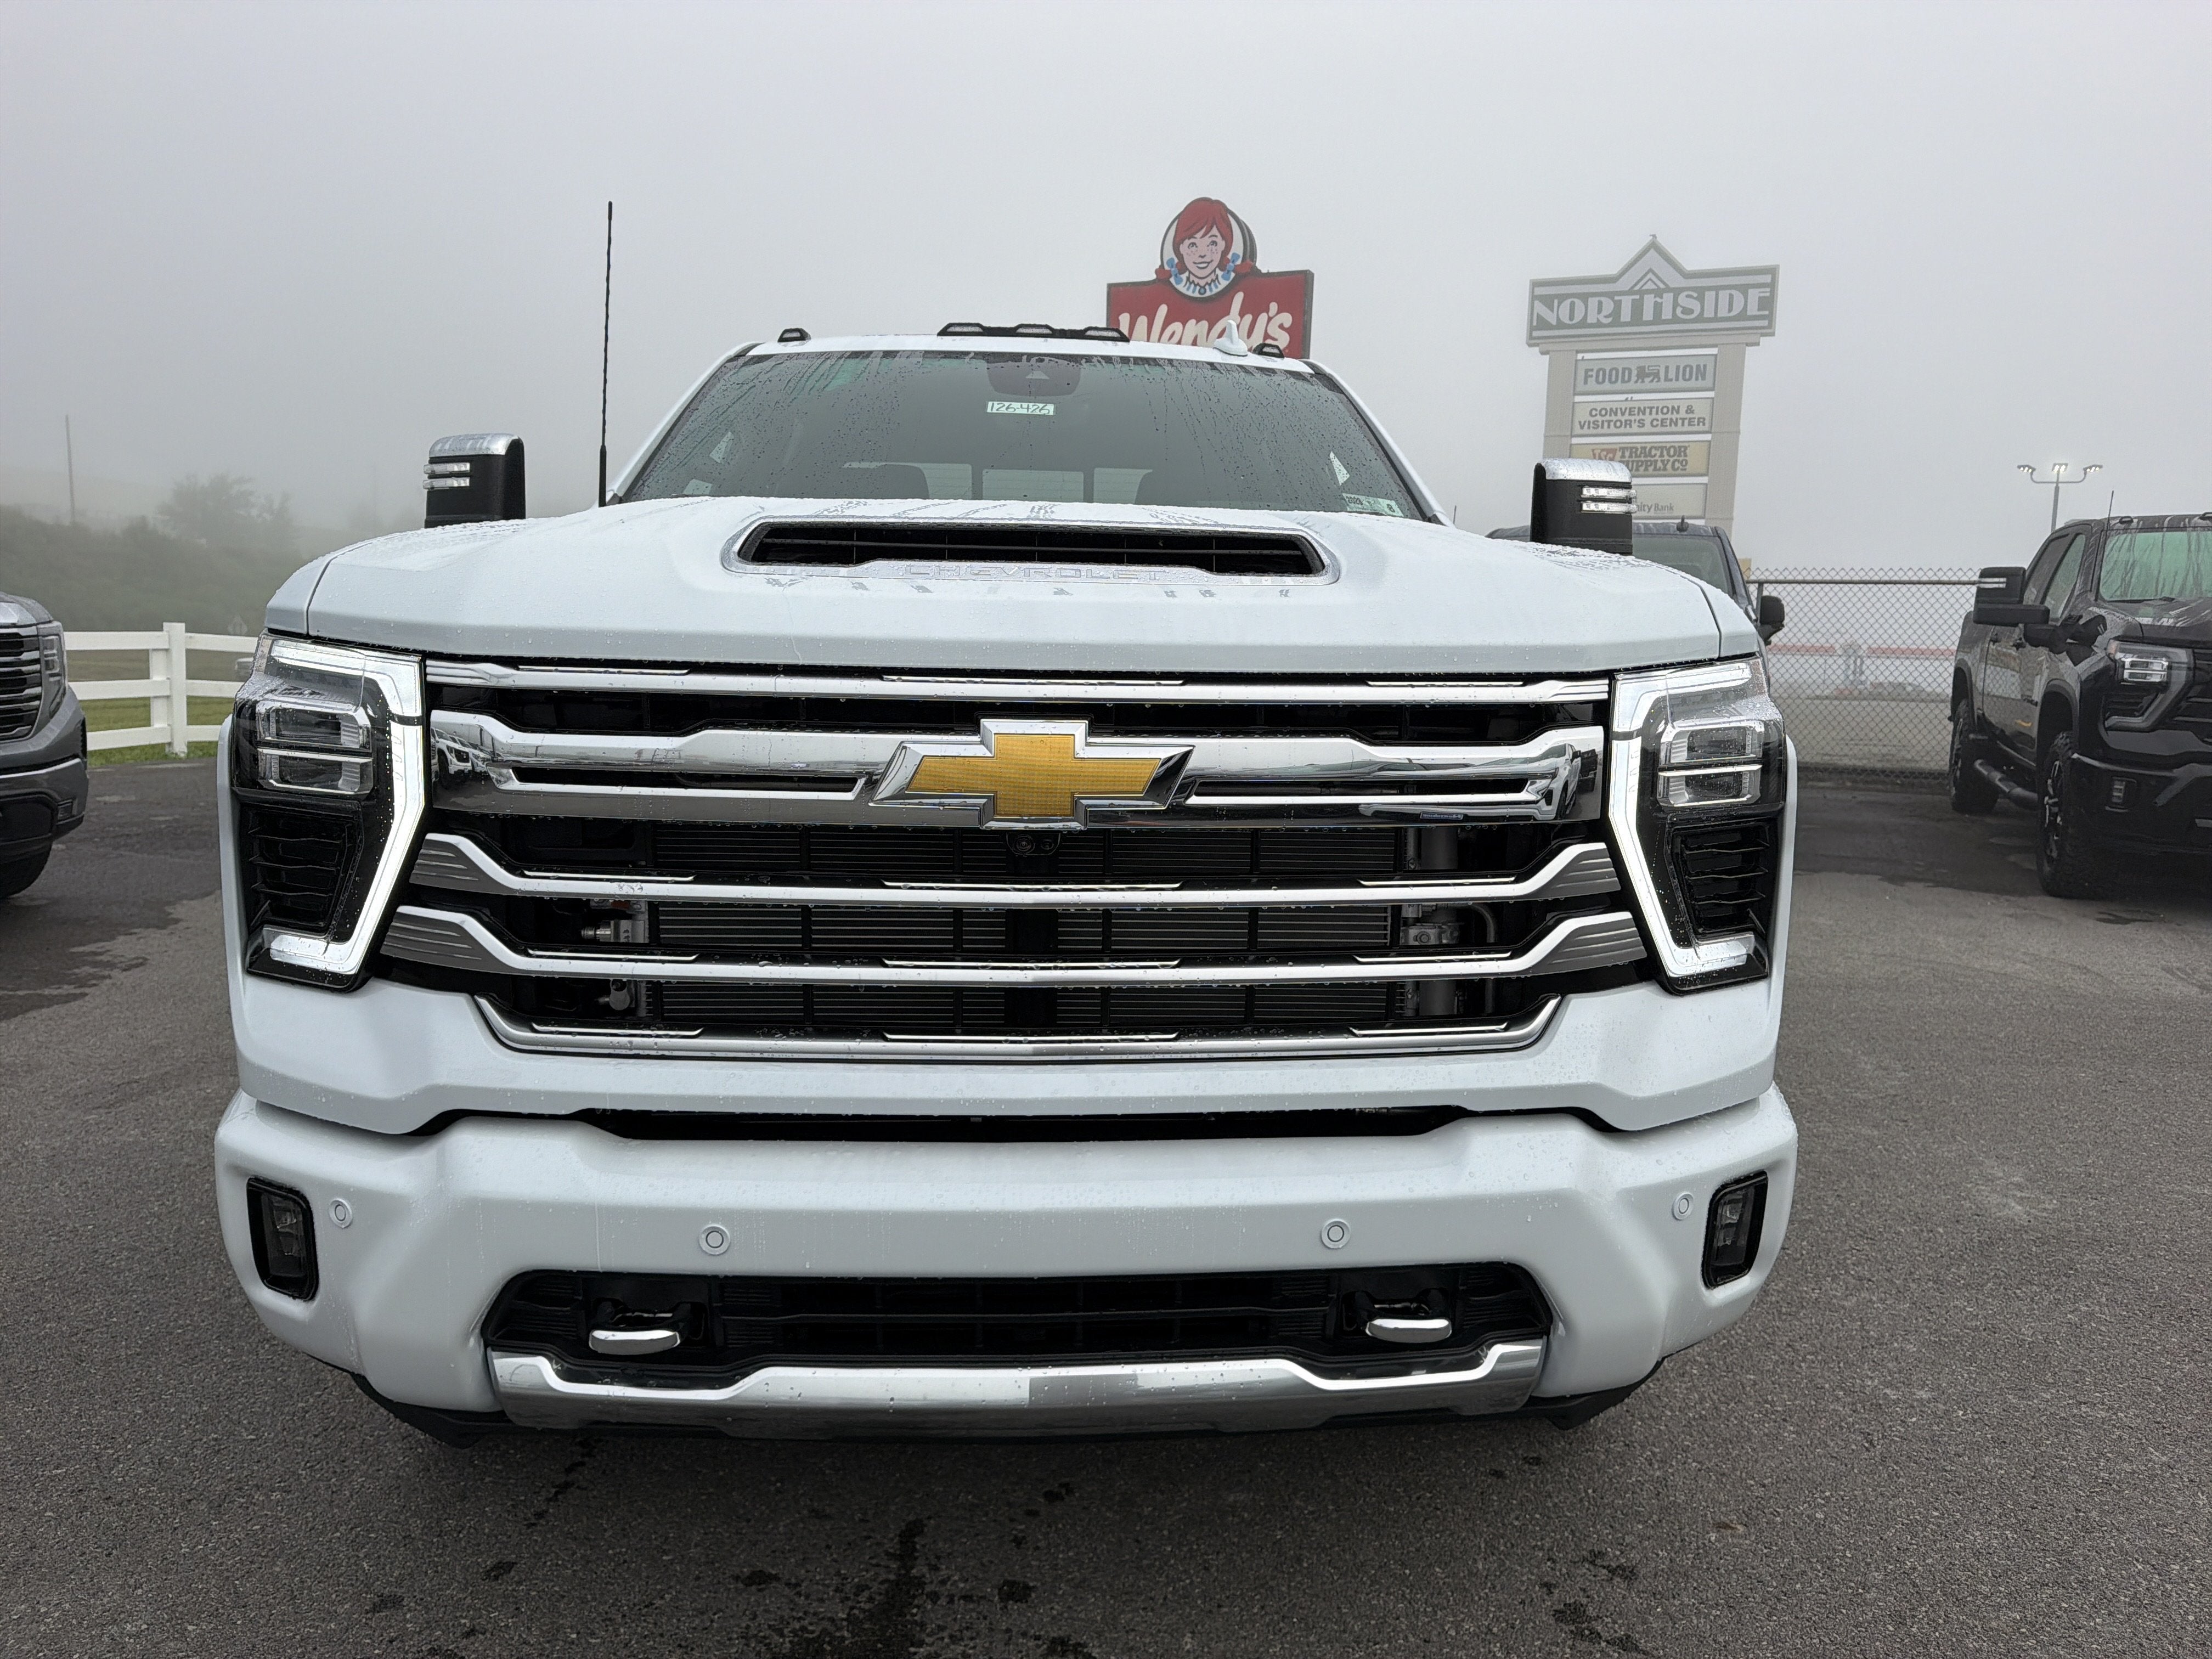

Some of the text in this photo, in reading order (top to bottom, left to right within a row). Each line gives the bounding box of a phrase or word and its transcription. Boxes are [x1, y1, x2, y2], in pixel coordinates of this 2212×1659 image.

[1533, 287, 1771, 326] NORTHSIDE
[1118, 291, 1293, 353] Wendy's
[1583, 364, 1708, 385] FOOD LION
[990, 402, 1051, 415] 126-426
[1588, 404, 1695, 418] CONVENTION &
[1578, 417, 1706, 430] VISITOR'S CENTER
[1618, 445, 1689, 459] TRACTOR
[1619, 459, 1670, 472] UPPLY
[1654, 503, 1674, 512] Bank
[903, 565, 1166, 580] CHEVROLET
